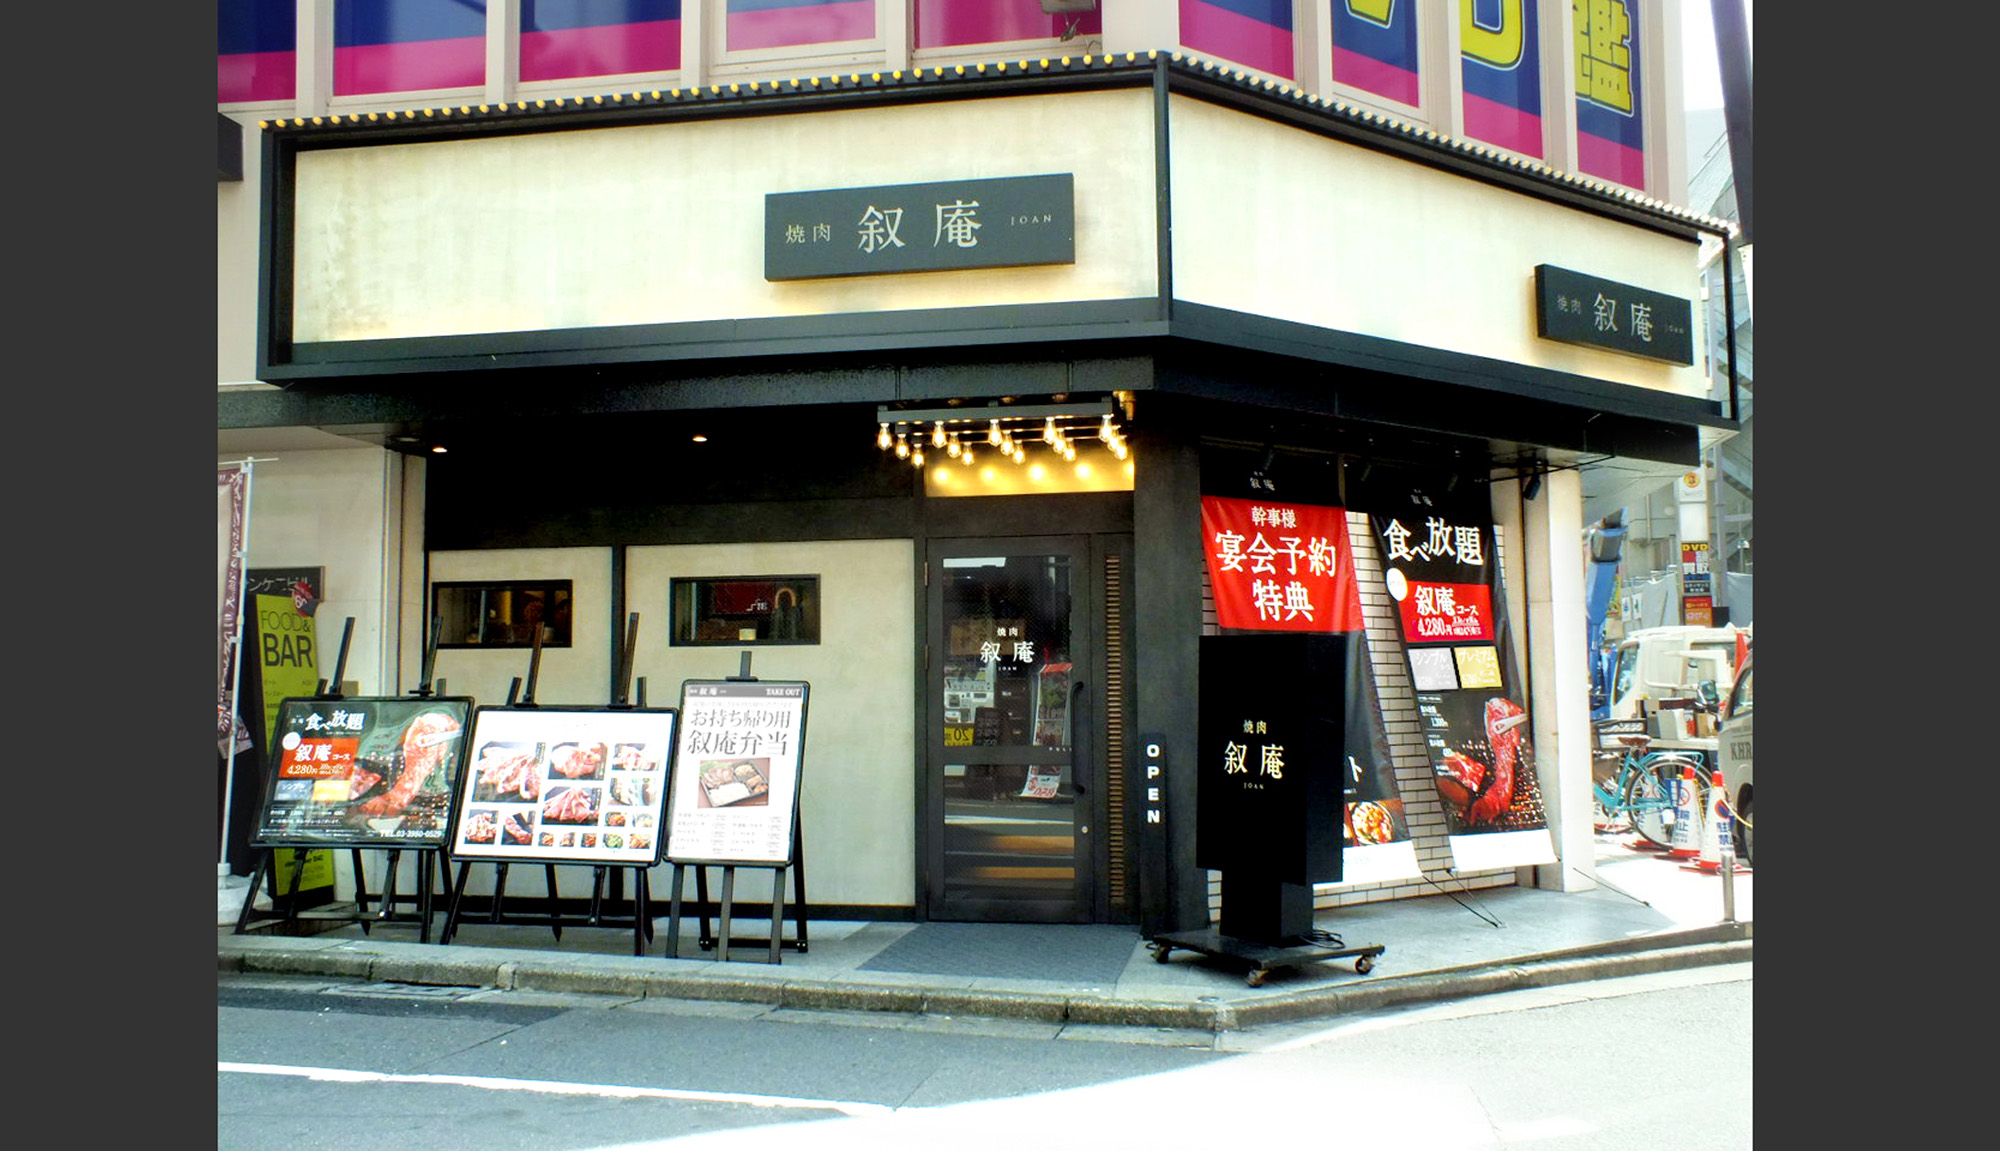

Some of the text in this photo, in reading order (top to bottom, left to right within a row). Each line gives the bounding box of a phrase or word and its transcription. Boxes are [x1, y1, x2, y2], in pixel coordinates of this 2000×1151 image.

[785, 200, 1053, 253] 焼肉 叙庵 JOAN
[1593, 292, 1653, 342] 叙庵
[1251, 506, 1297, 529] 幹事様
[1215, 530, 1336, 577] 宴会予約
[1383, 516, 1484, 566] 食べ放題
[1252, 579, 1314, 622] 特典
[1414, 585, 1480, 617] 叙庵 コース
[261, 611, 303, 632] FOOD
[997, 626, 1018, 637] 焼肉
[264, 633, 313, 668] BAR
[980, 641, 1035, 663] 叙庵
[766, 688, 784, 696] TAKE
[305, 709, 365, 731] 食べ放題
[690, 709, 791, 728] お持ち帰り用
[1243, 719, 1267, 734] 焼肉
[294, 744, 333, 762] 叙庵
[687, 729, 788, 756] 叙庵弁当
[1224, 740, 1285, 779] 叙庵
[1146, 744, 1160, 824] OPEN
